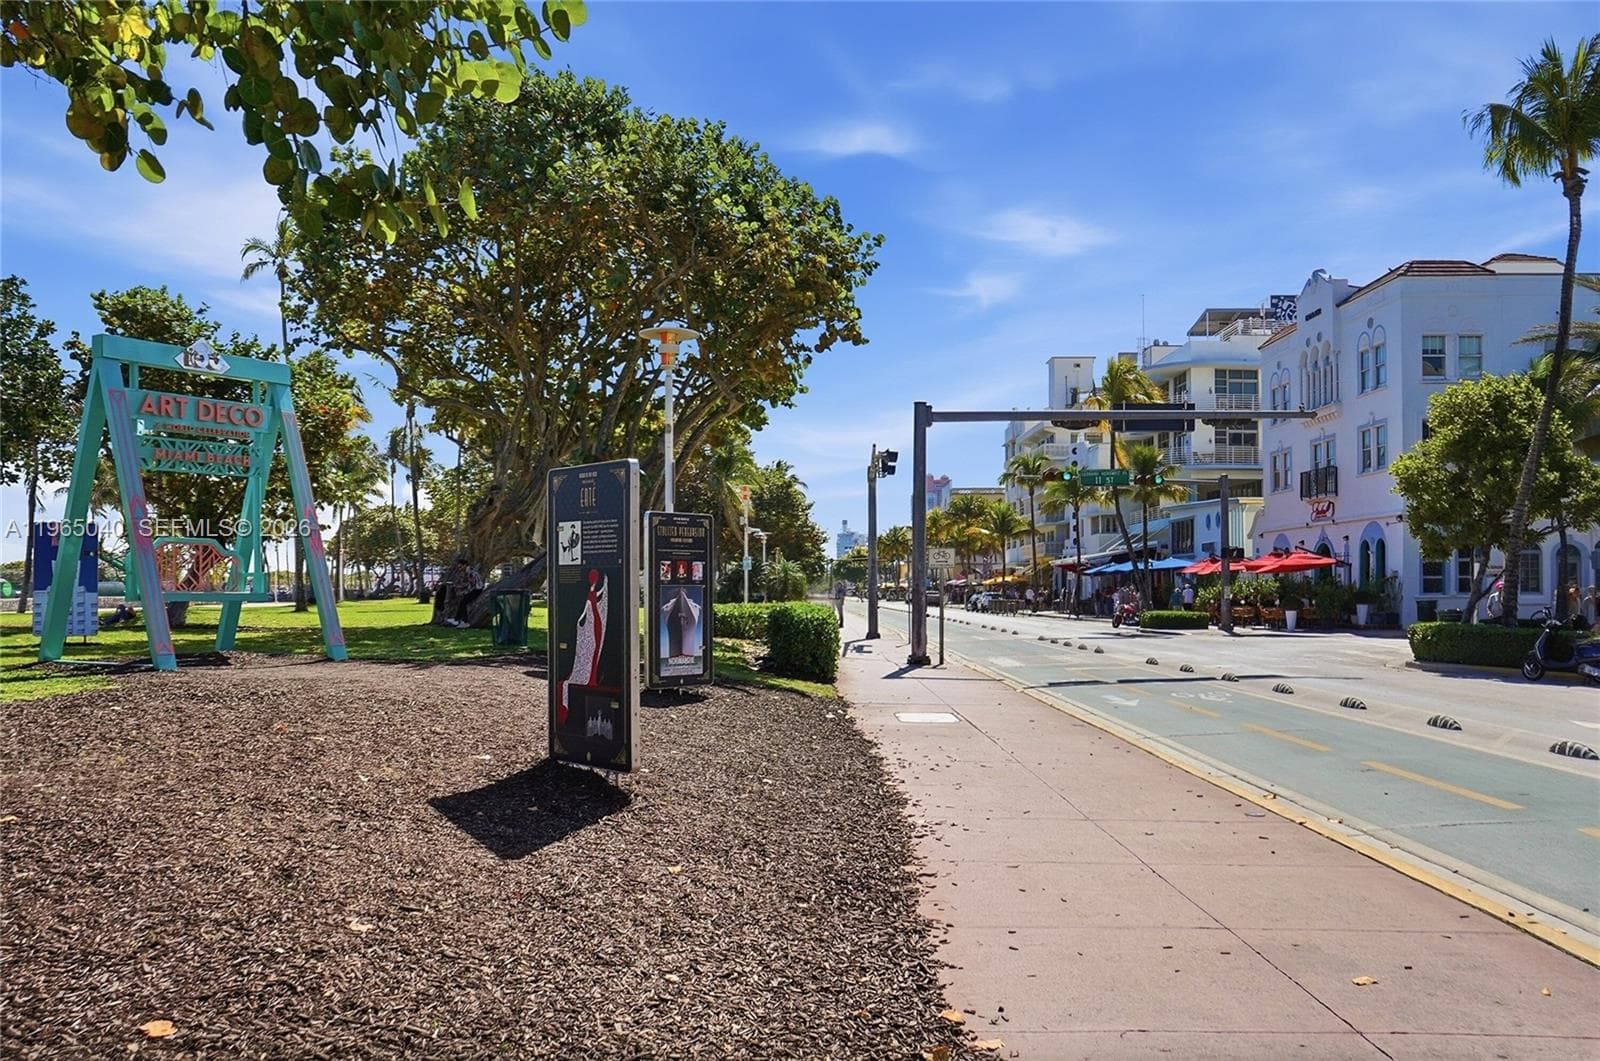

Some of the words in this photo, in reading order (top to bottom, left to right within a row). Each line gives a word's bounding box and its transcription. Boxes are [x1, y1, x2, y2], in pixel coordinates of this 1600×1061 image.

[140, 394, 188, 419] ART
[197, 401, 264, 428] DECO
[153, 447, 199, 461] MIAMI
[206, 453, 250, 467] BEACH
[1095, 476, 1102, 484] 11
